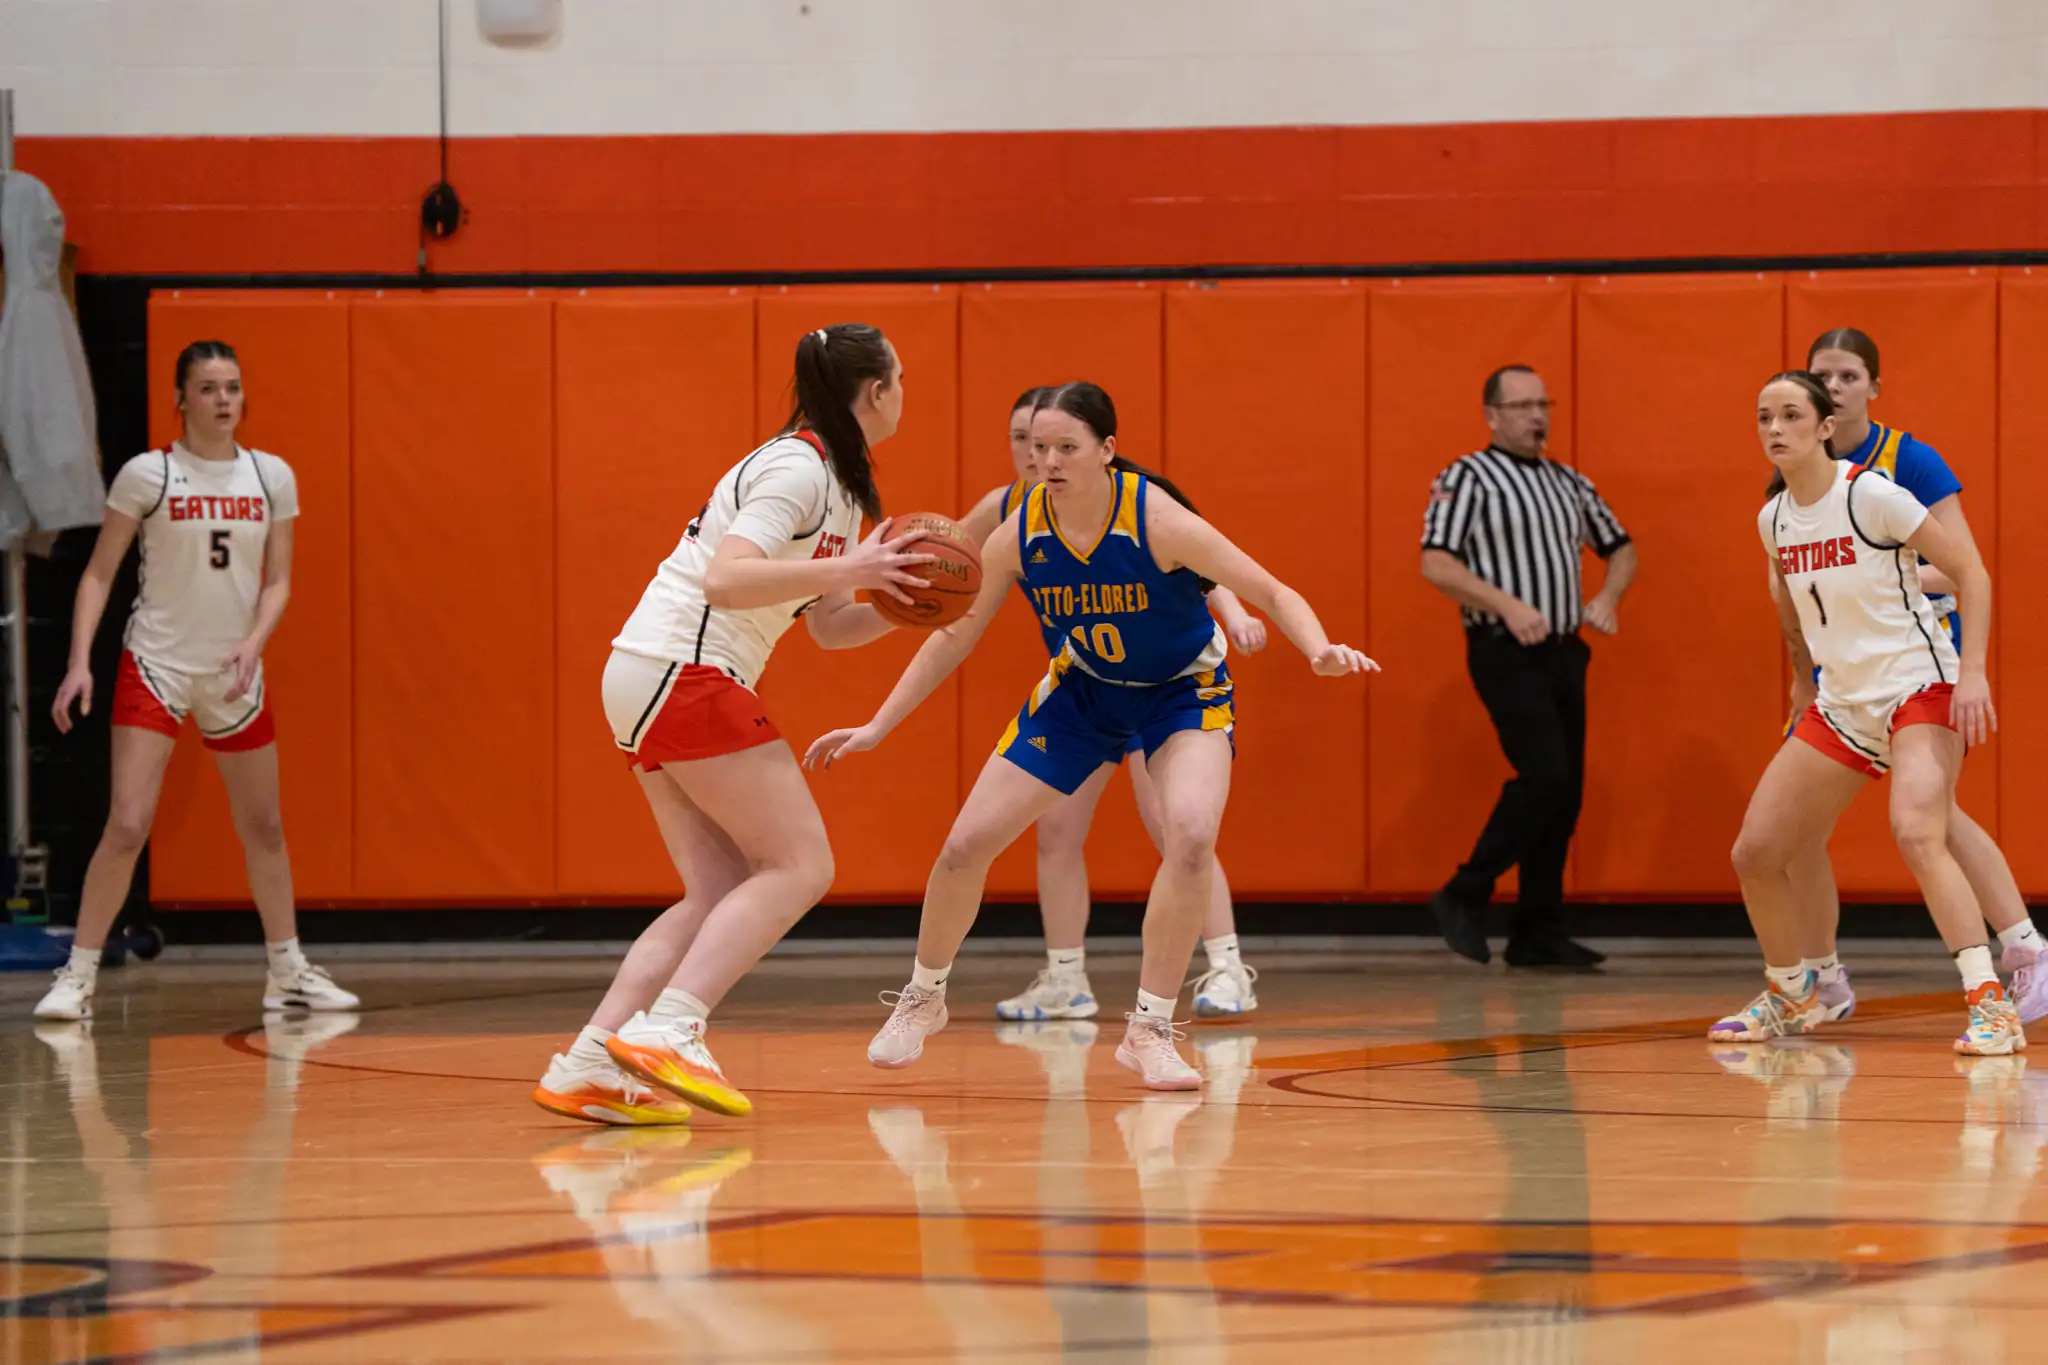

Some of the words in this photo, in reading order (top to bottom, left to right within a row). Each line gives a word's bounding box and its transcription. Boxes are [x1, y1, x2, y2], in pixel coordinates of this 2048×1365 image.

[168, 495, 264, 522] GATORS
[210, 529, 232, 570] 5
[1778, 535, 1857, 575] GATORS
[1808, 581, 1828, 628] 1
